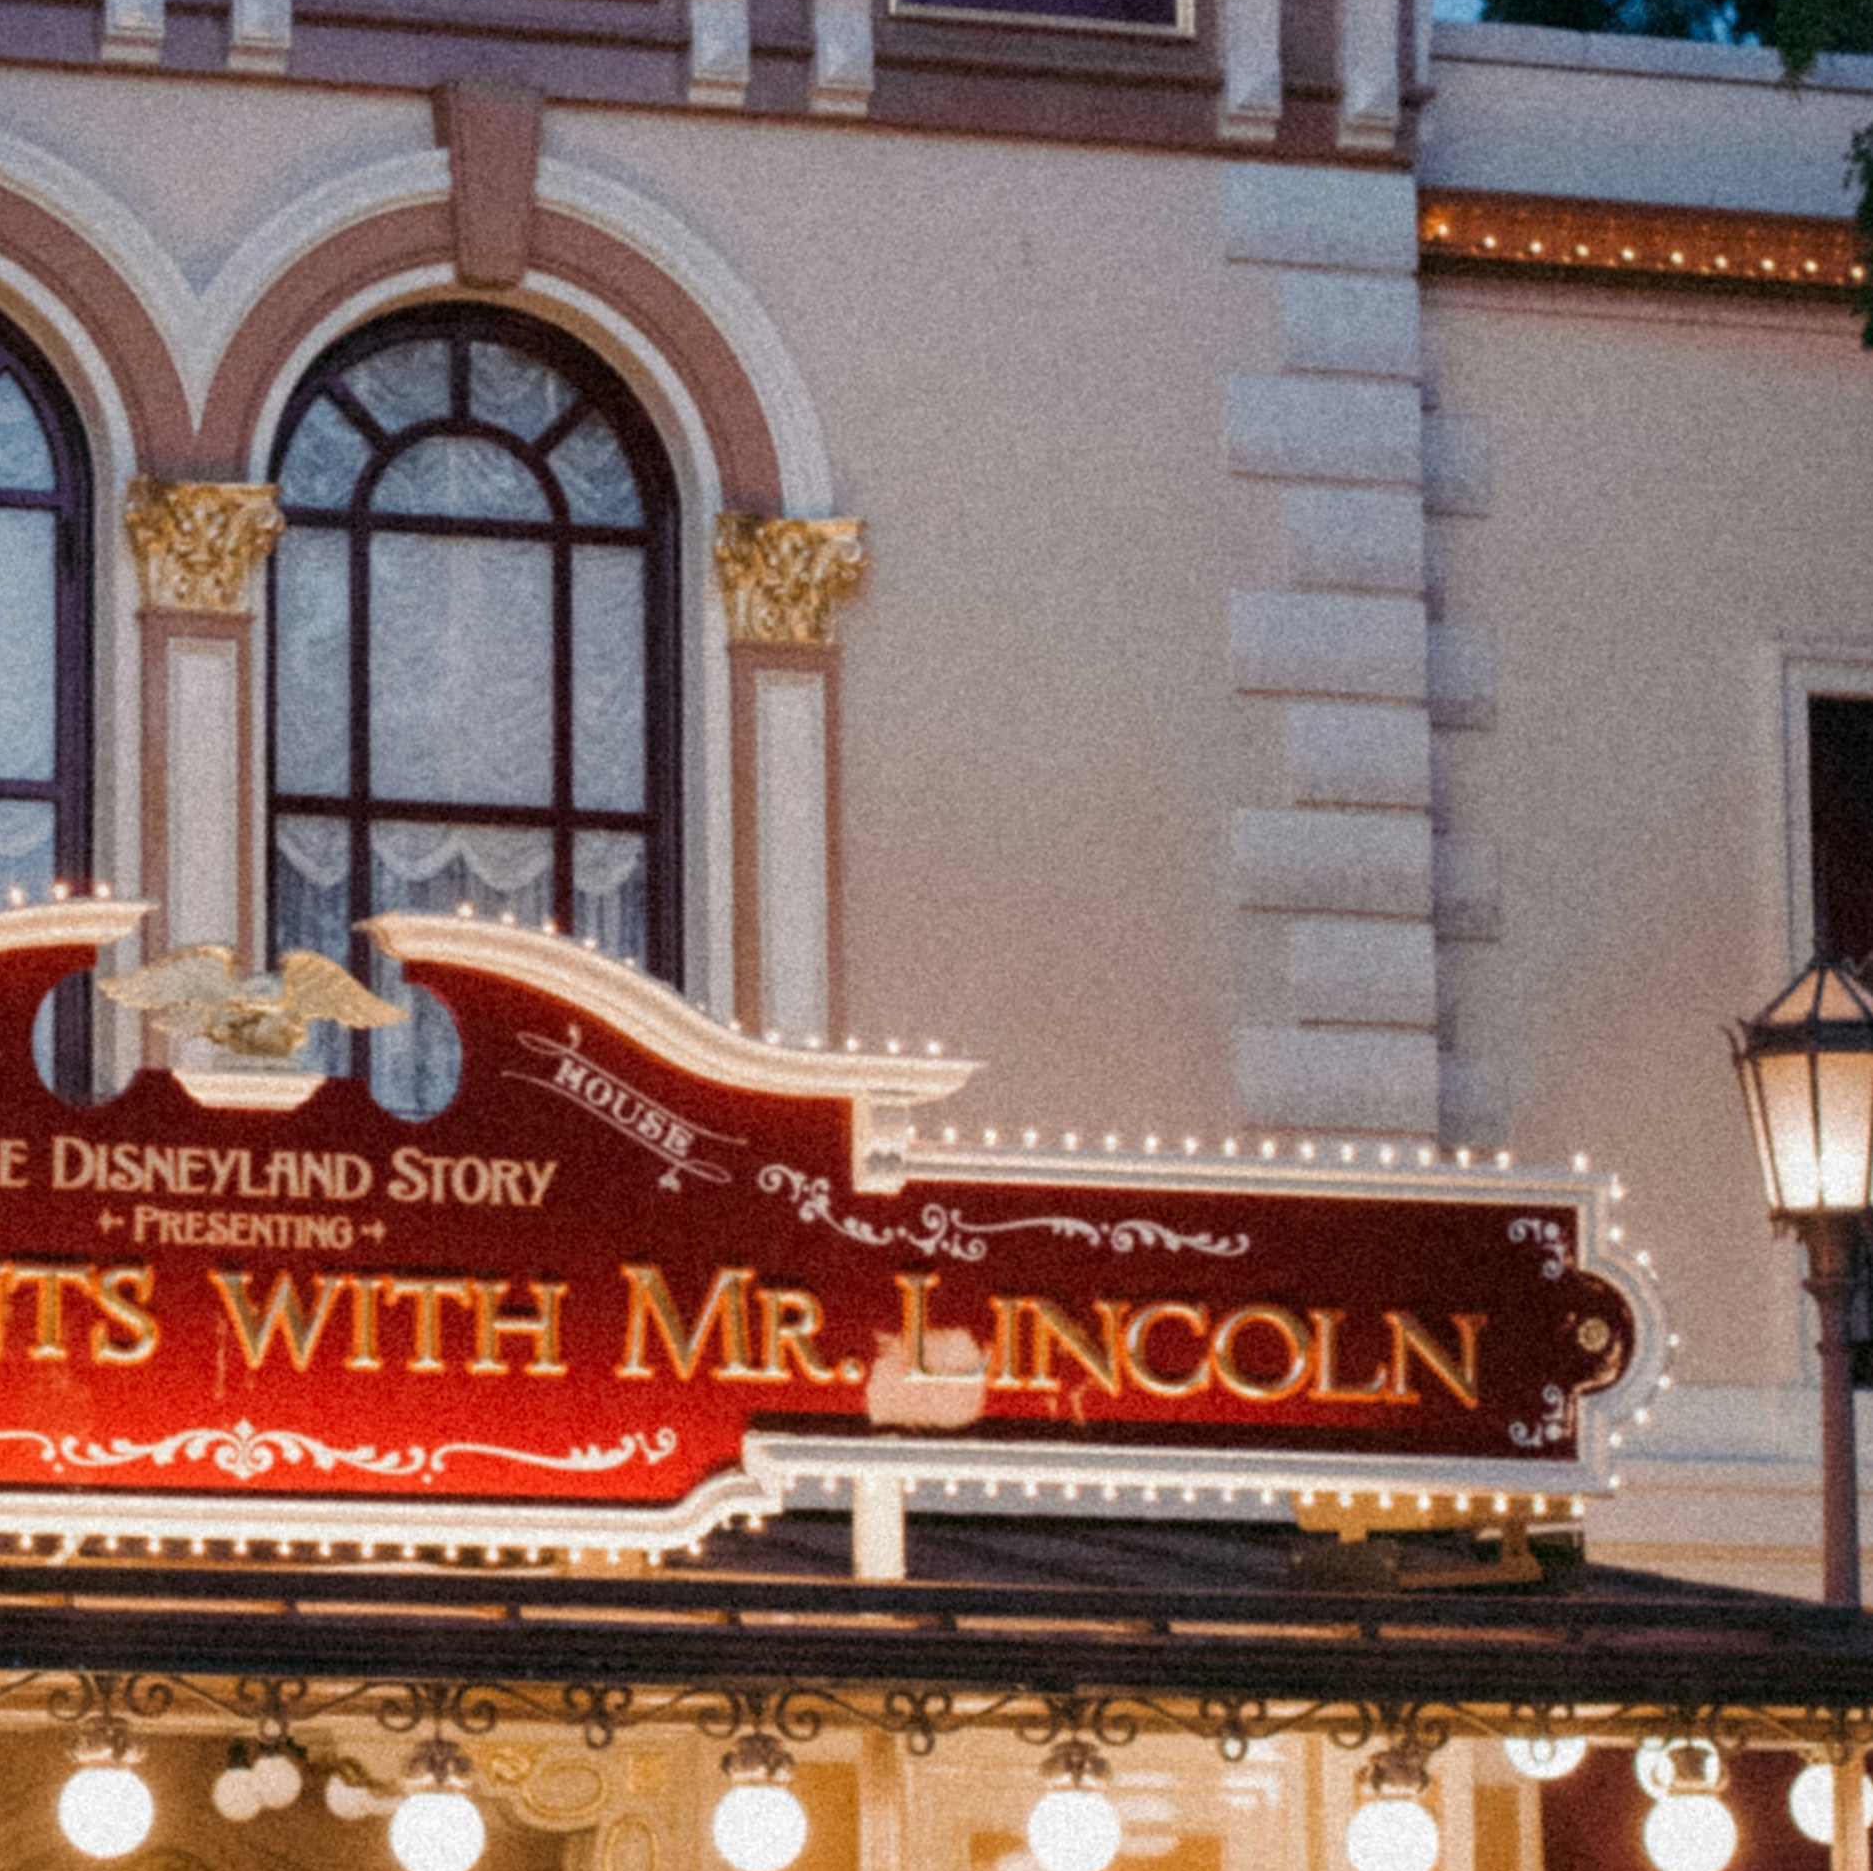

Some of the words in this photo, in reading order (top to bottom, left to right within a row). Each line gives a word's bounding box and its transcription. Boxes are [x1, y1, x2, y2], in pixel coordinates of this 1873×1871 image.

[552, 1057, 696, 1159] HOUSE
[51, 1135, 374, 1201] DISNEYLAND
[387, 1146, 559, 1208] STORY
[133, 1204, 355, 1251] PRESENTING
[208, 1266, 570, 1376] WITH
[615, 1263, 867, 1385] MR.
[895, 1270, 1490, 1410] LINCOLN
